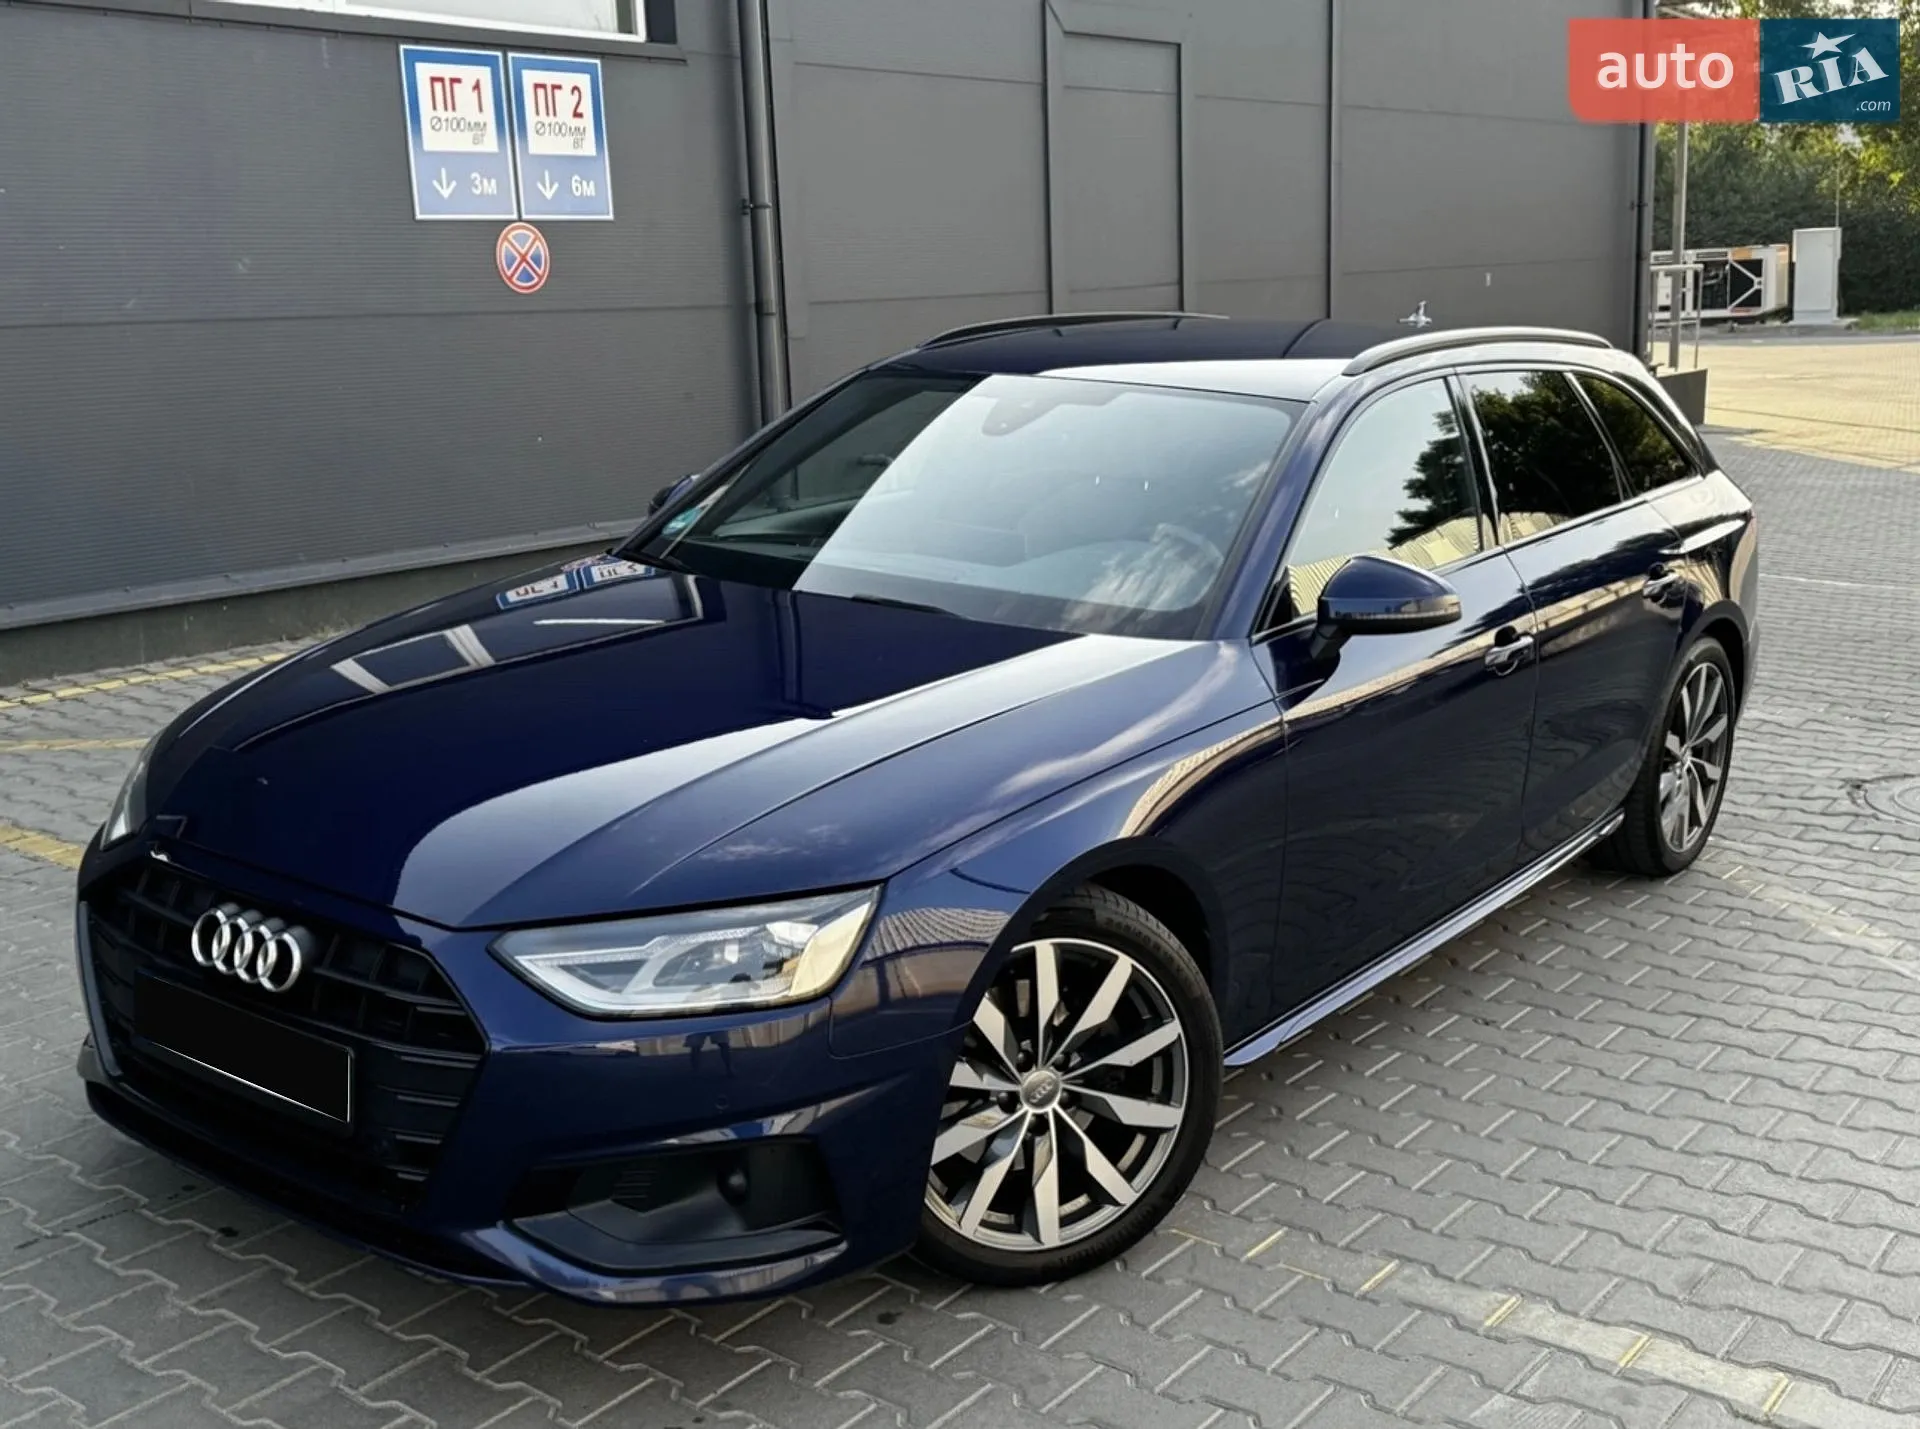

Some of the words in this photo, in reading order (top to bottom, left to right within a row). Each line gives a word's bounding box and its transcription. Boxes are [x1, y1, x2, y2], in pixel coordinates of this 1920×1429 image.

[429, 76, 463, 112] ПГ
[471, 78, 483, 113] 1
[532, 83, 562, 117] ПГ
[570, 85, 584, 119] 2
